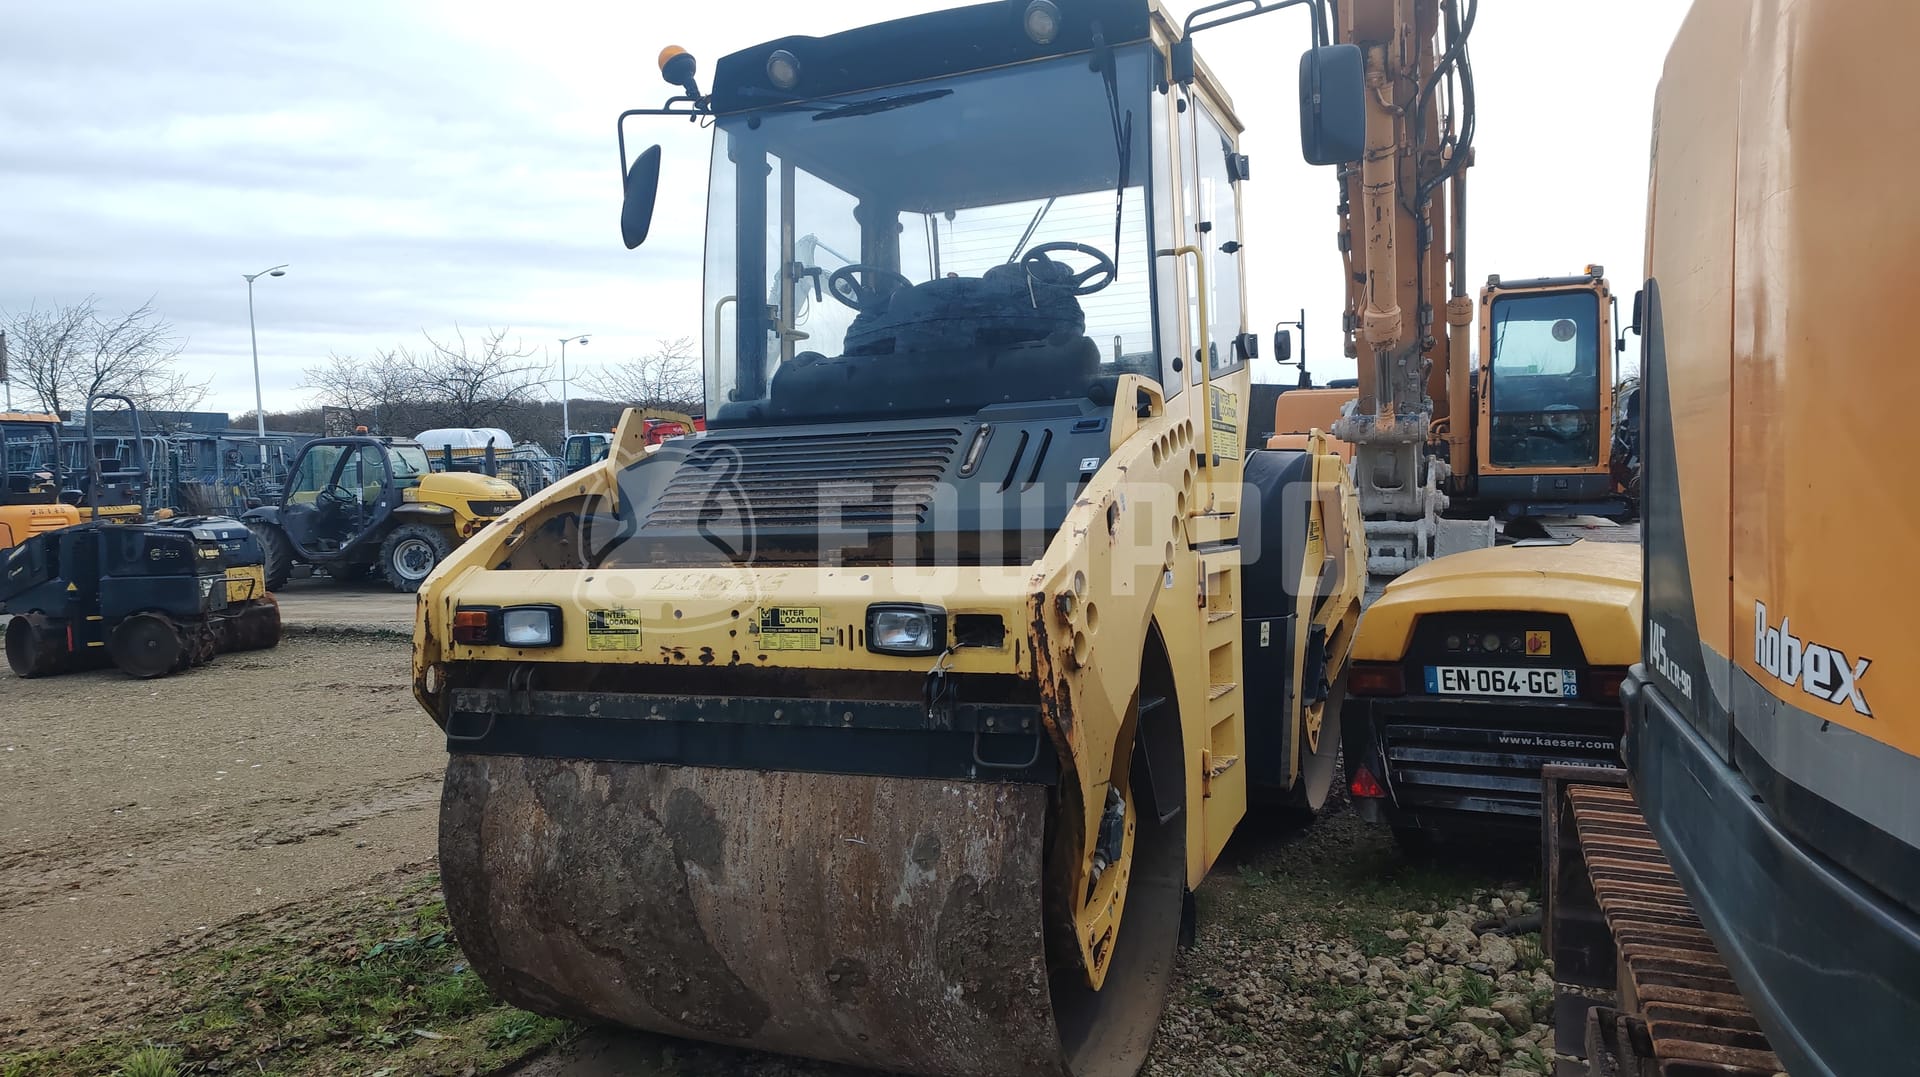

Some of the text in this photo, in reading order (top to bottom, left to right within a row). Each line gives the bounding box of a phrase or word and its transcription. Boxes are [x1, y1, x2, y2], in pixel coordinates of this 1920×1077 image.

[605, 610, 627, 618] INTER
[781, 609, 804, 617] INTER
[605, 618, 639, 626] LOCATION
[1754, 599, 1874, 719] Robex
[1441, 668, 1559, 694] EN-064-GC
[1563, 683, 1577, 695] 28
[1498, 734, 1615, 750] www.kaeser.com
